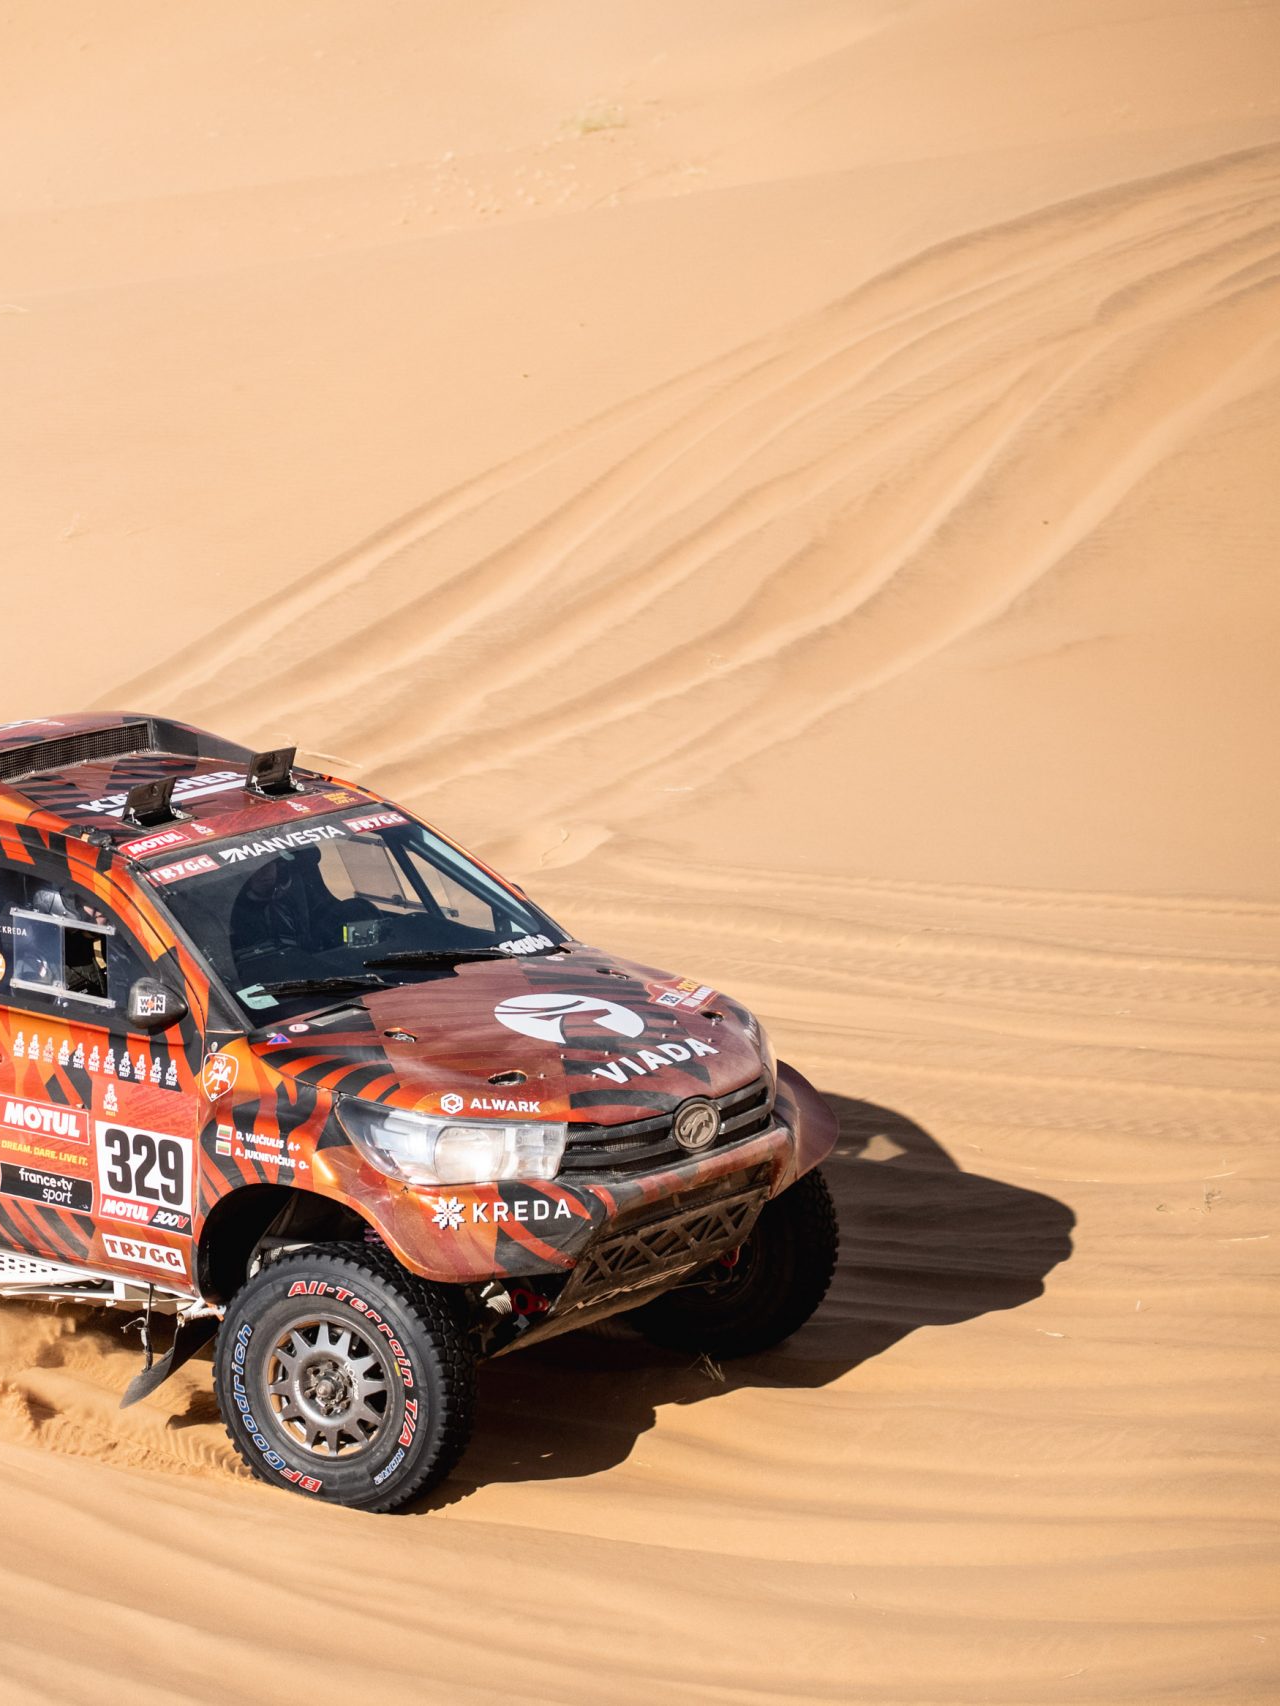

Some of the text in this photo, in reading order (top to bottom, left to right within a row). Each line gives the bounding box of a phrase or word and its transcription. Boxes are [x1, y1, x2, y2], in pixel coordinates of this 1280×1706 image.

[347, 813, 407, 832] TRYGG
[128, 833, 183, 854] MOTUL
[237, 824, 346, 862] MANVESTA
[592, 1037, 719, 1084] VIADA
[470, 1098, 540, 1113] ALWARK
[4, 1101, 80, 1138] MOTUL
[1, 1140, 33, 1154] DREAM.
[33, 1147, 58, 1160] DARE.
[59, 1154, 78, 1164] LIVE
[105, 1128, 184, 1206] 329
[42, 1187, 72, 1204] sport
[102, 1199, 149, 1221] MOTUL
[153, 1212, 190, 1229] 300V
[472, 1198, 571, 1223] KREDA
[105, 1239, 182, 1267] TRYGG
[288, 1280, 414, 1388] All-Terrain
[230, 1322, 322, 1493] BFGoodrich
[398, 1398, 418, 1447] T/A
